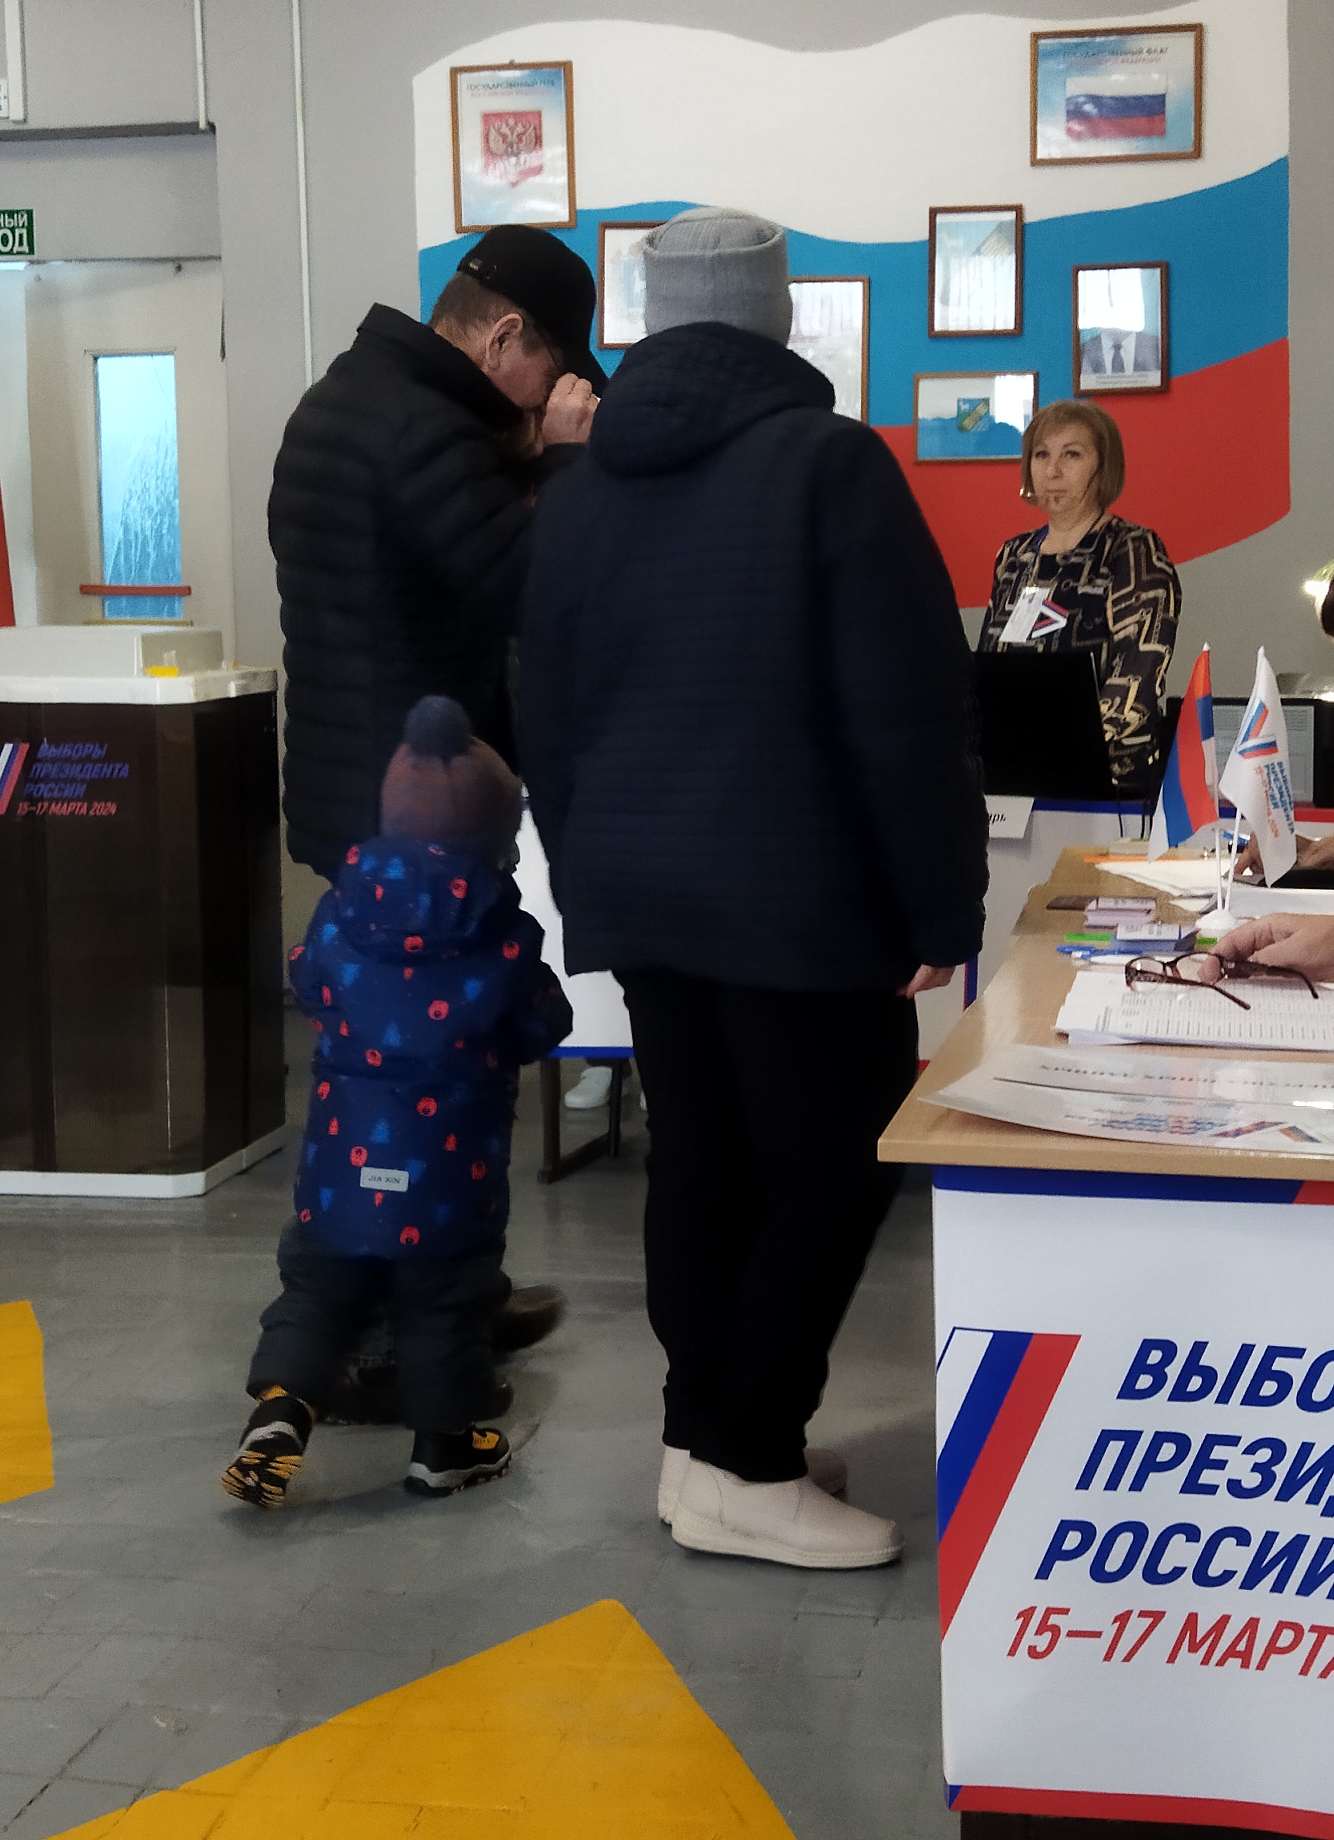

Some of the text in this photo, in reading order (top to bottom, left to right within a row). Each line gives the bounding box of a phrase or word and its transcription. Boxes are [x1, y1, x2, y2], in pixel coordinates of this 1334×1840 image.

[36, 743, 108, 759] ВЫБОРЫ
[29, 762, 130, 779] ПРЕЗИДЕНТА
[24, 782, 87, 798] РОССИИ
[50, 801, 88, 815] МАРТА
[89, 801, 117, 815] 2024
